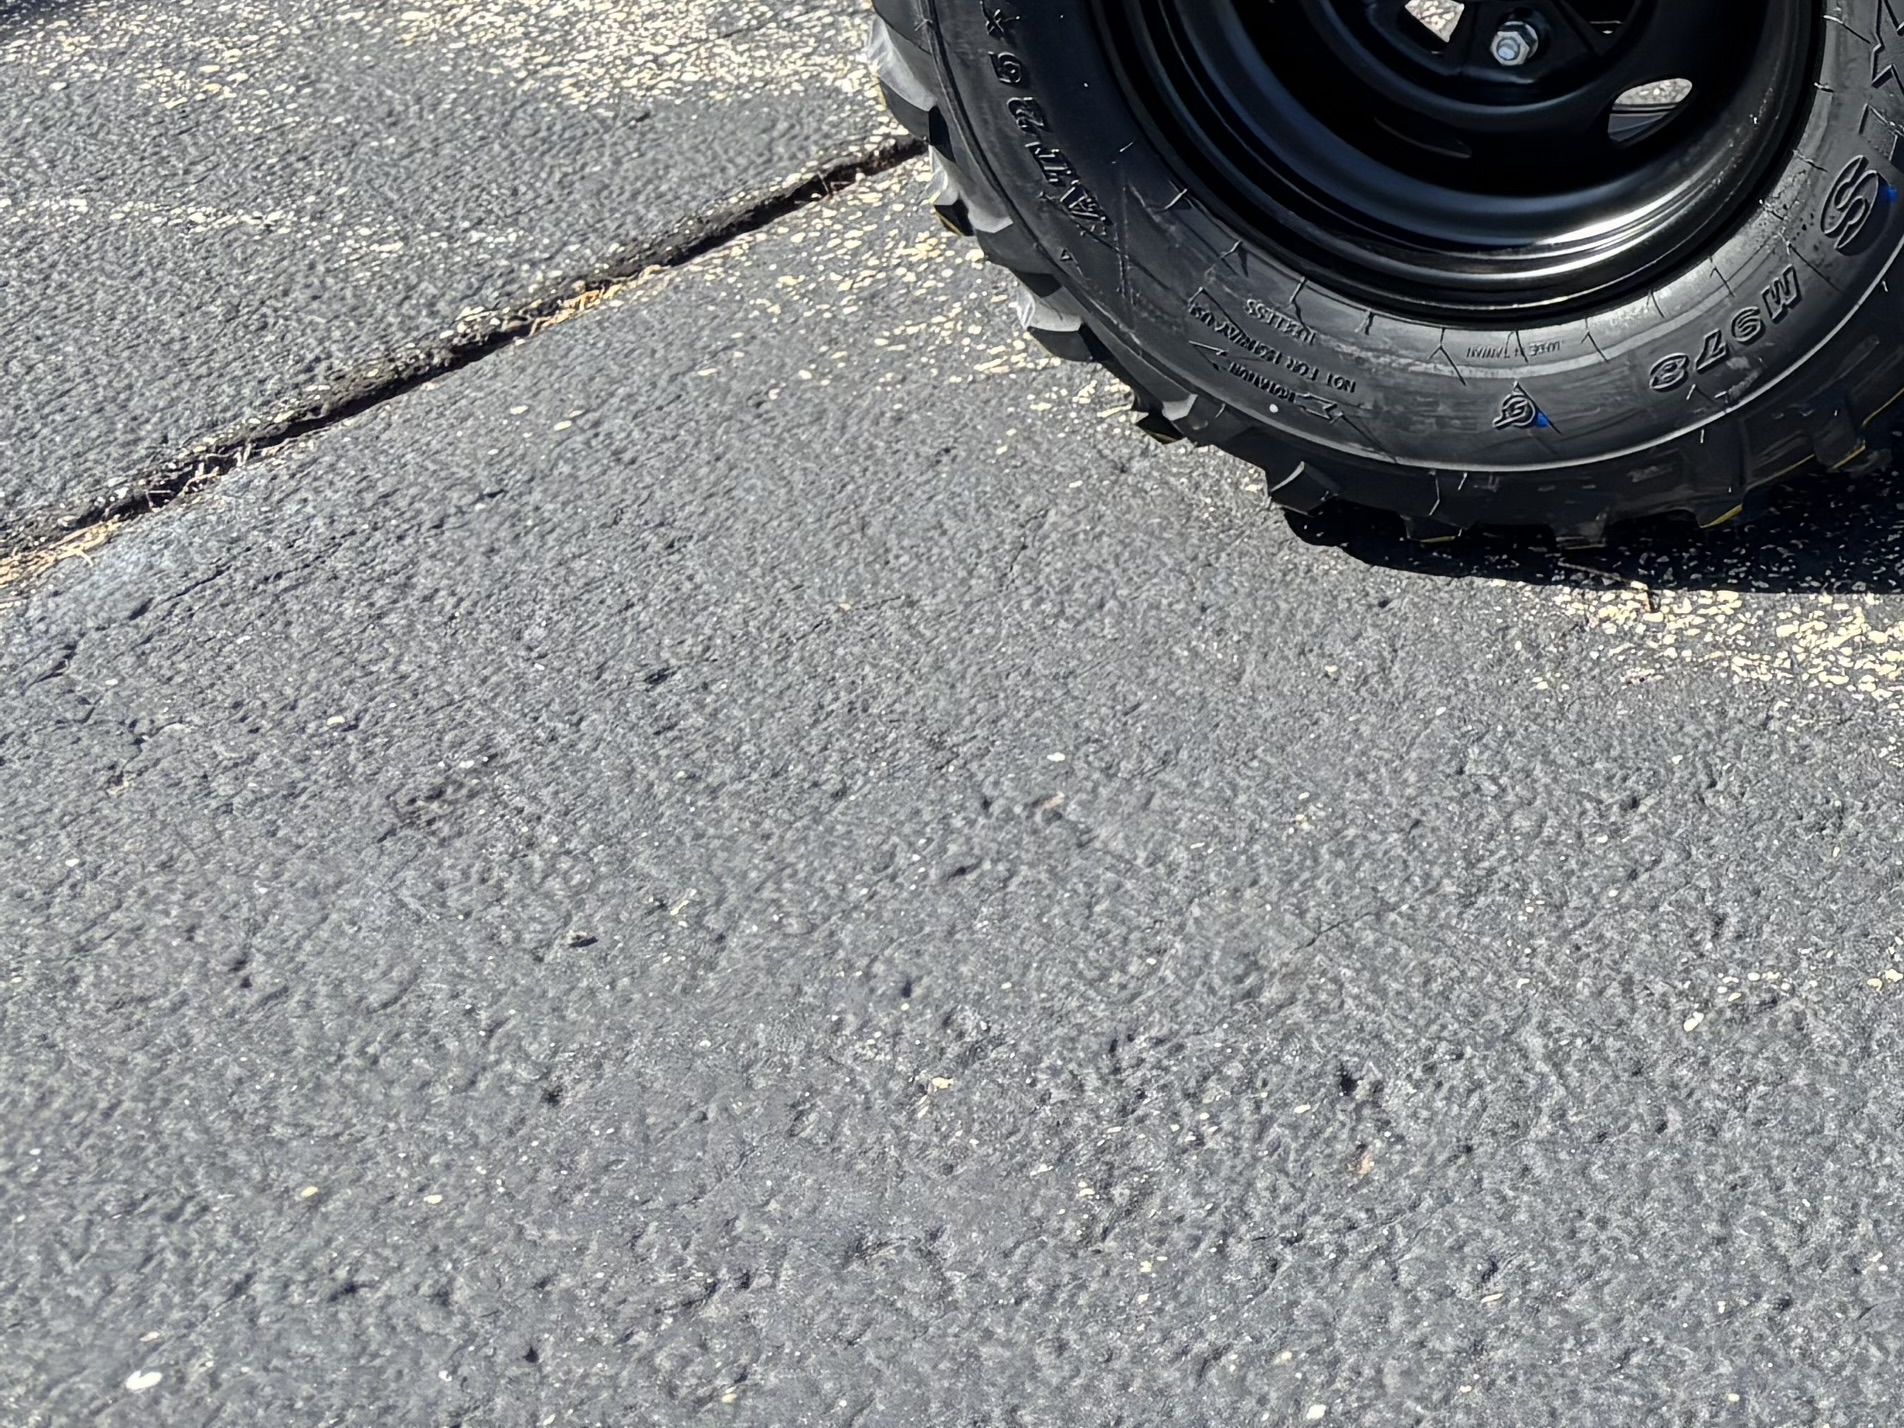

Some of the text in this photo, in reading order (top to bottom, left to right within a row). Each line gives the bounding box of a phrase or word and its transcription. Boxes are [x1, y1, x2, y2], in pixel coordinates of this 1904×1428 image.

[1649, 265, 1803, 393] M978
[1284, 355, 1319, 381] FOR
[1324, 370, 1357, 394] NOT
